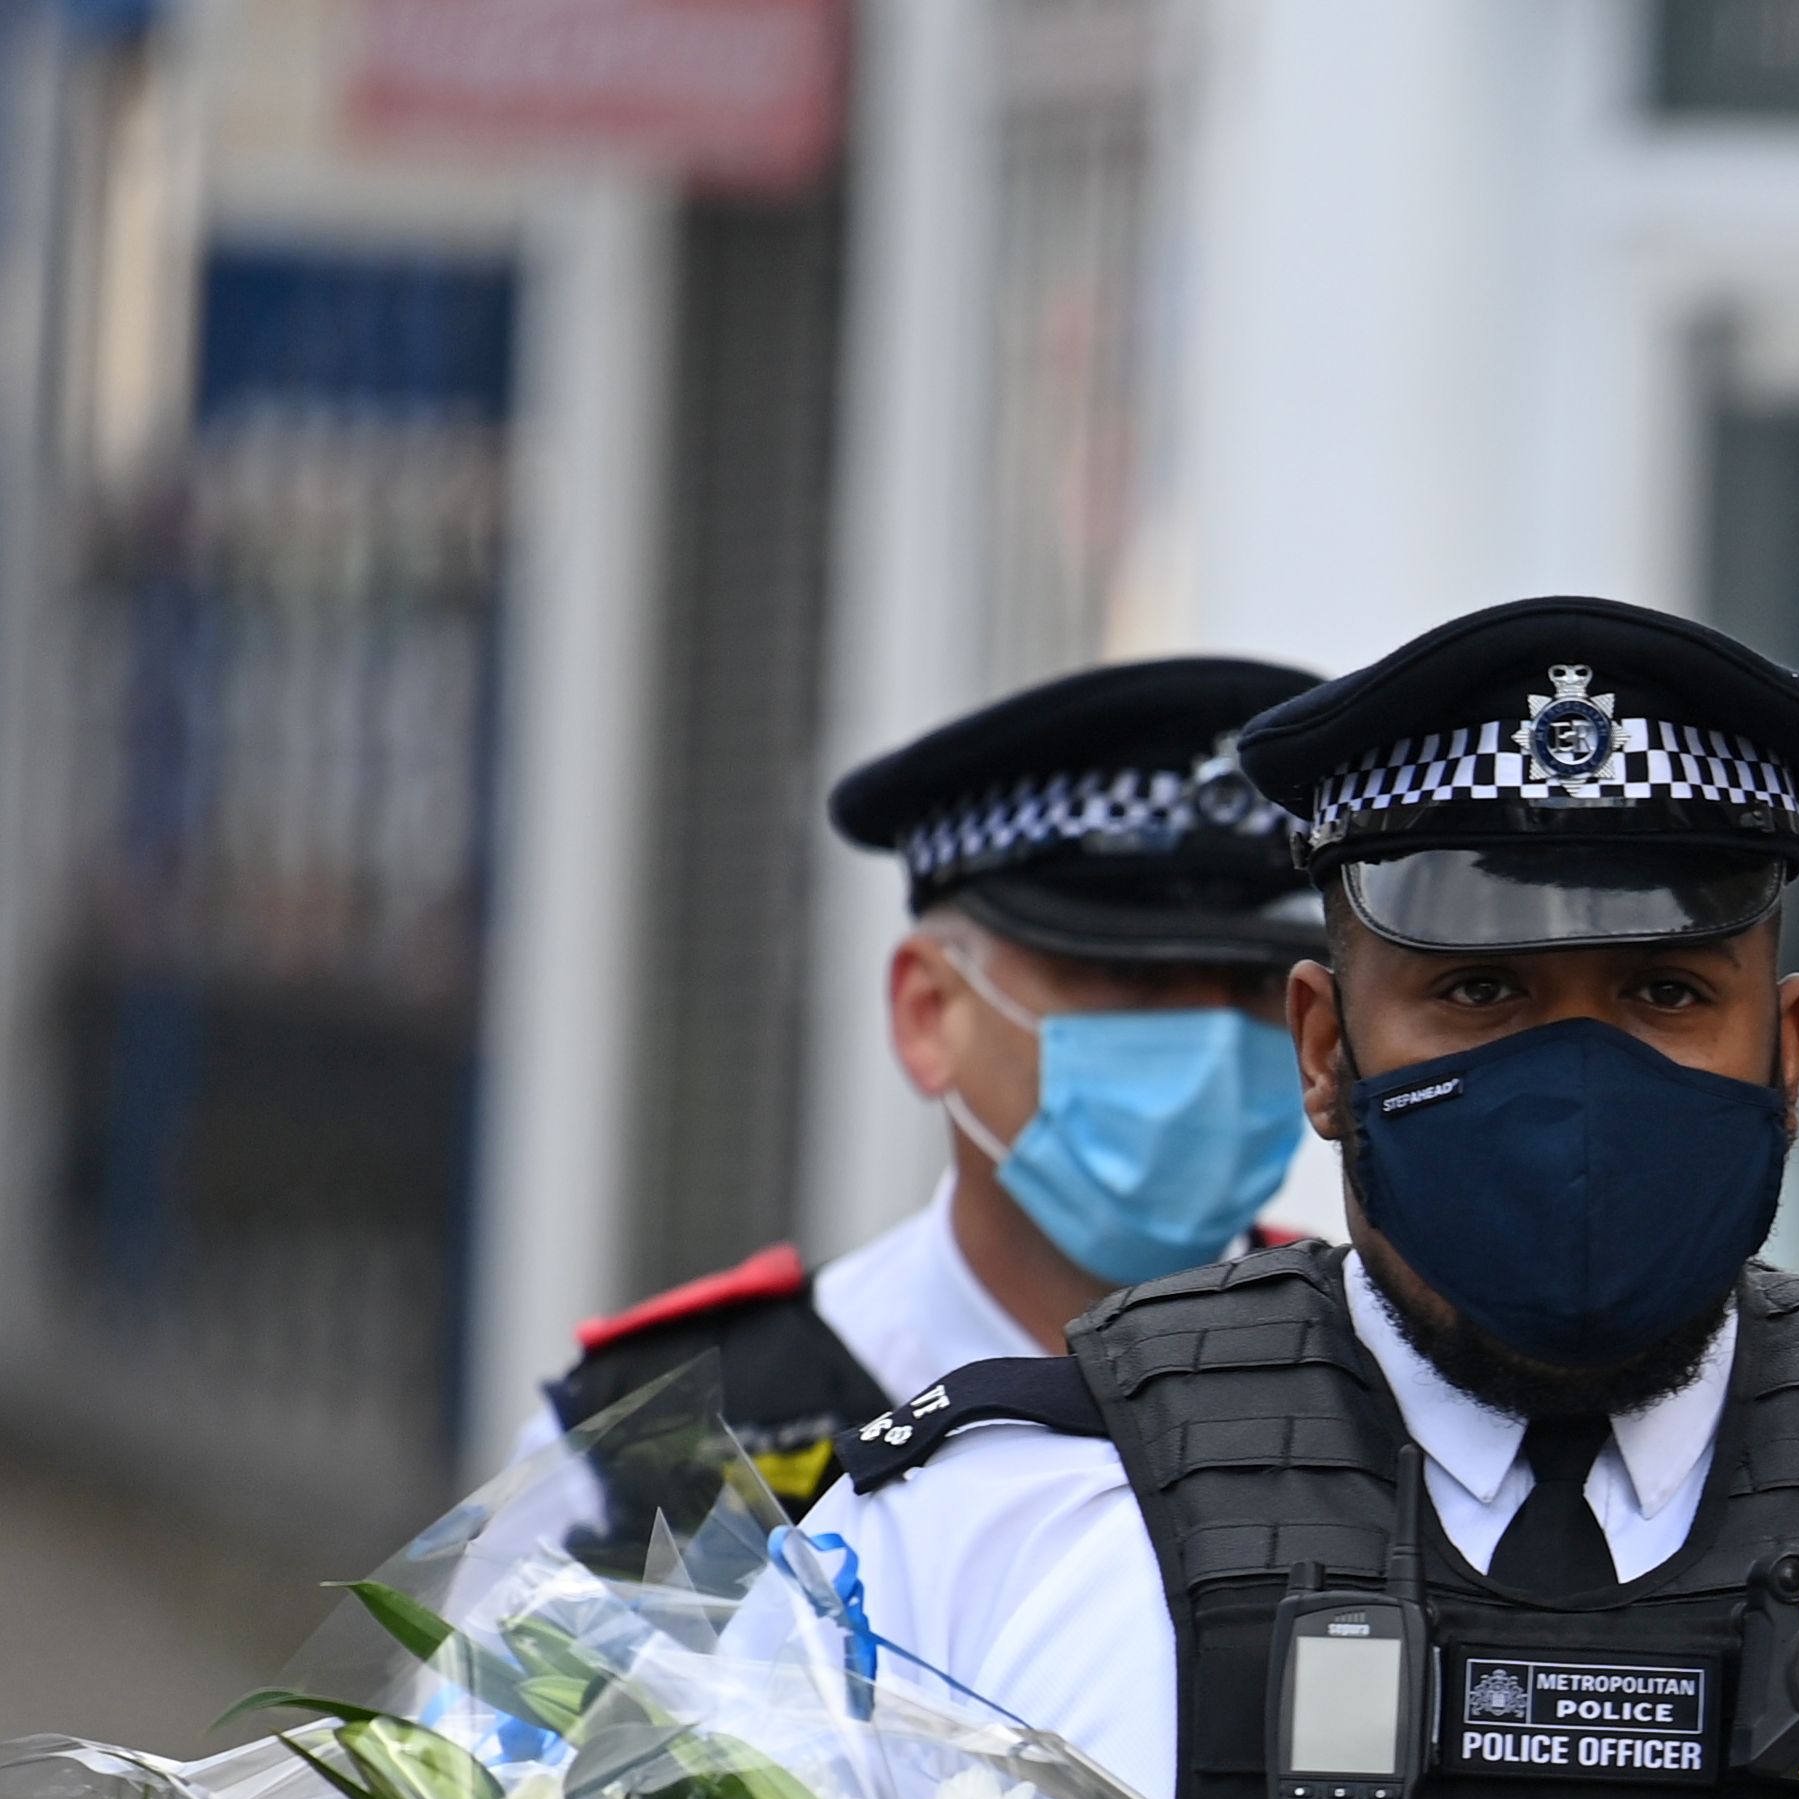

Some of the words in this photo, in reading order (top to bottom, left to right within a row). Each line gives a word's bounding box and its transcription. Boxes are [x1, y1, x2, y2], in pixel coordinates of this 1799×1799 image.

[1536, 1673, 1696, 1696] METROPOLITAN
[1556, 1700, 1674, 1723] POLICE
[1462, 1731, 1570, 1764] POLICE
[1578, 1737, 1702, 1770] OFFICER
